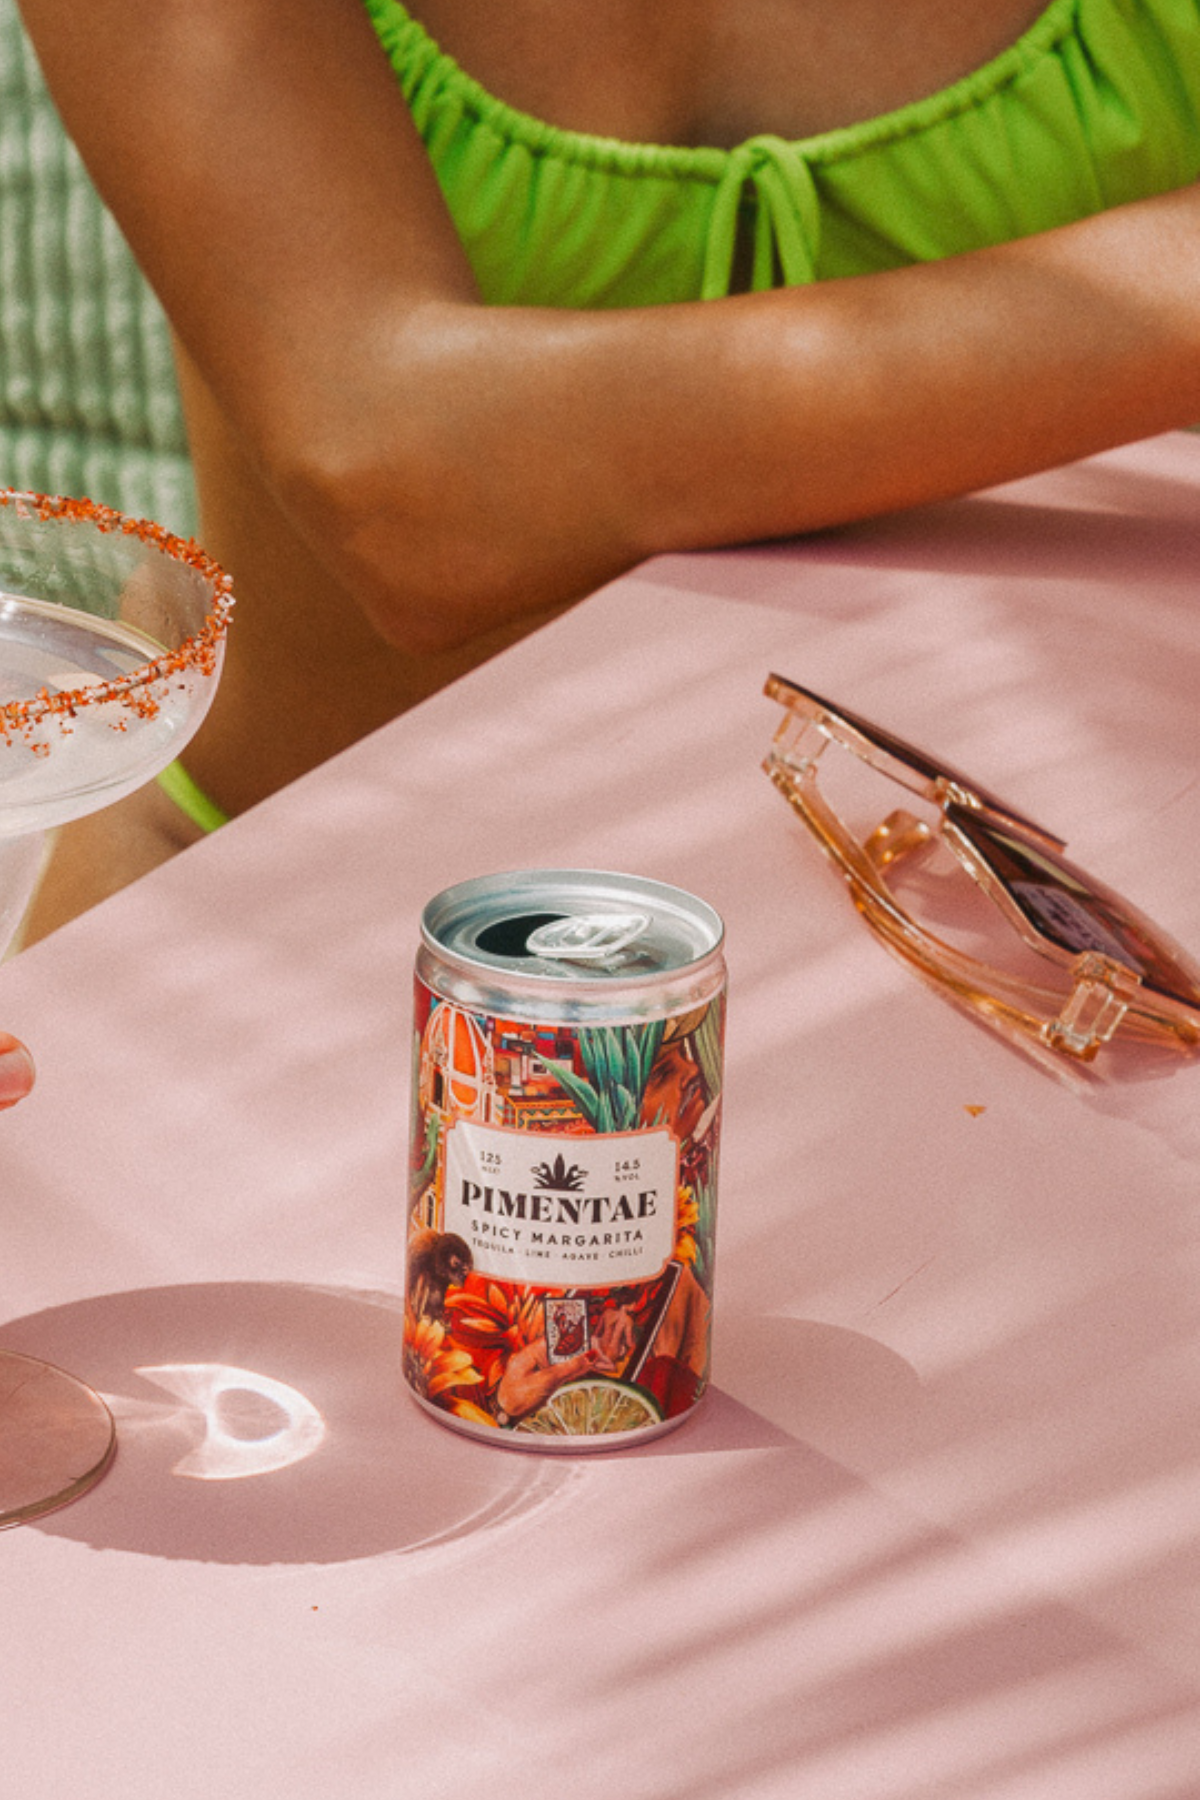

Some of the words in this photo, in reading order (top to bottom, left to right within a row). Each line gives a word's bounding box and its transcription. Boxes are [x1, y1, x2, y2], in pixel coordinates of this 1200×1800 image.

[480, 1150, 502, 1165] 125
[461, 1179, 658, 1225] PIMENTAE
[471, 1219, 521, 1241] SPICY
[531, 1228, 643, 1247] MARGARITA
